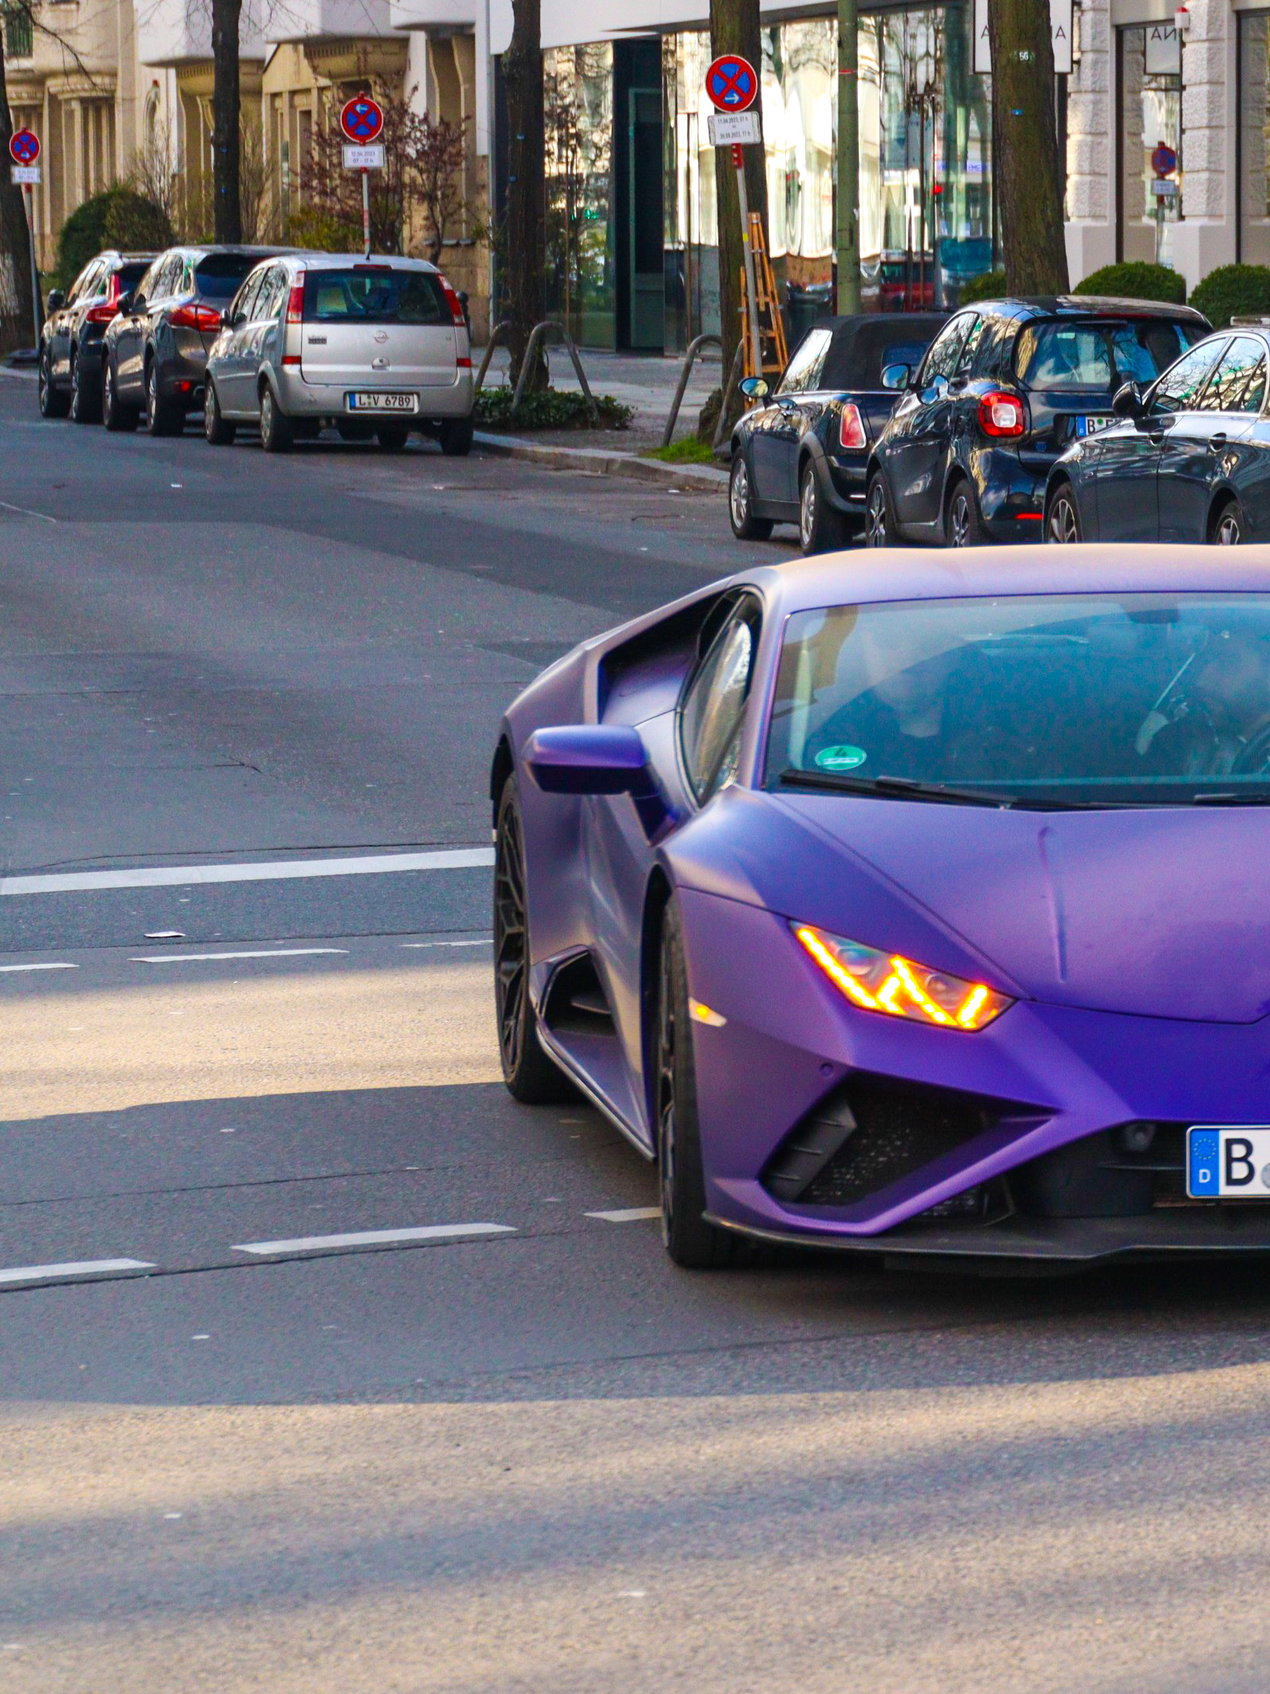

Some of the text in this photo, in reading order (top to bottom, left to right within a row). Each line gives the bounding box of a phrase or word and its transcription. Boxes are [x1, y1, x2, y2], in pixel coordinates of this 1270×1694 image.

[359, 395, 411, 407] L V 6789
[1088, 419, 1096, 434] B
[1225, 1137, 1256, 1187] B
[1198, 1169, 1211, 1183] D
